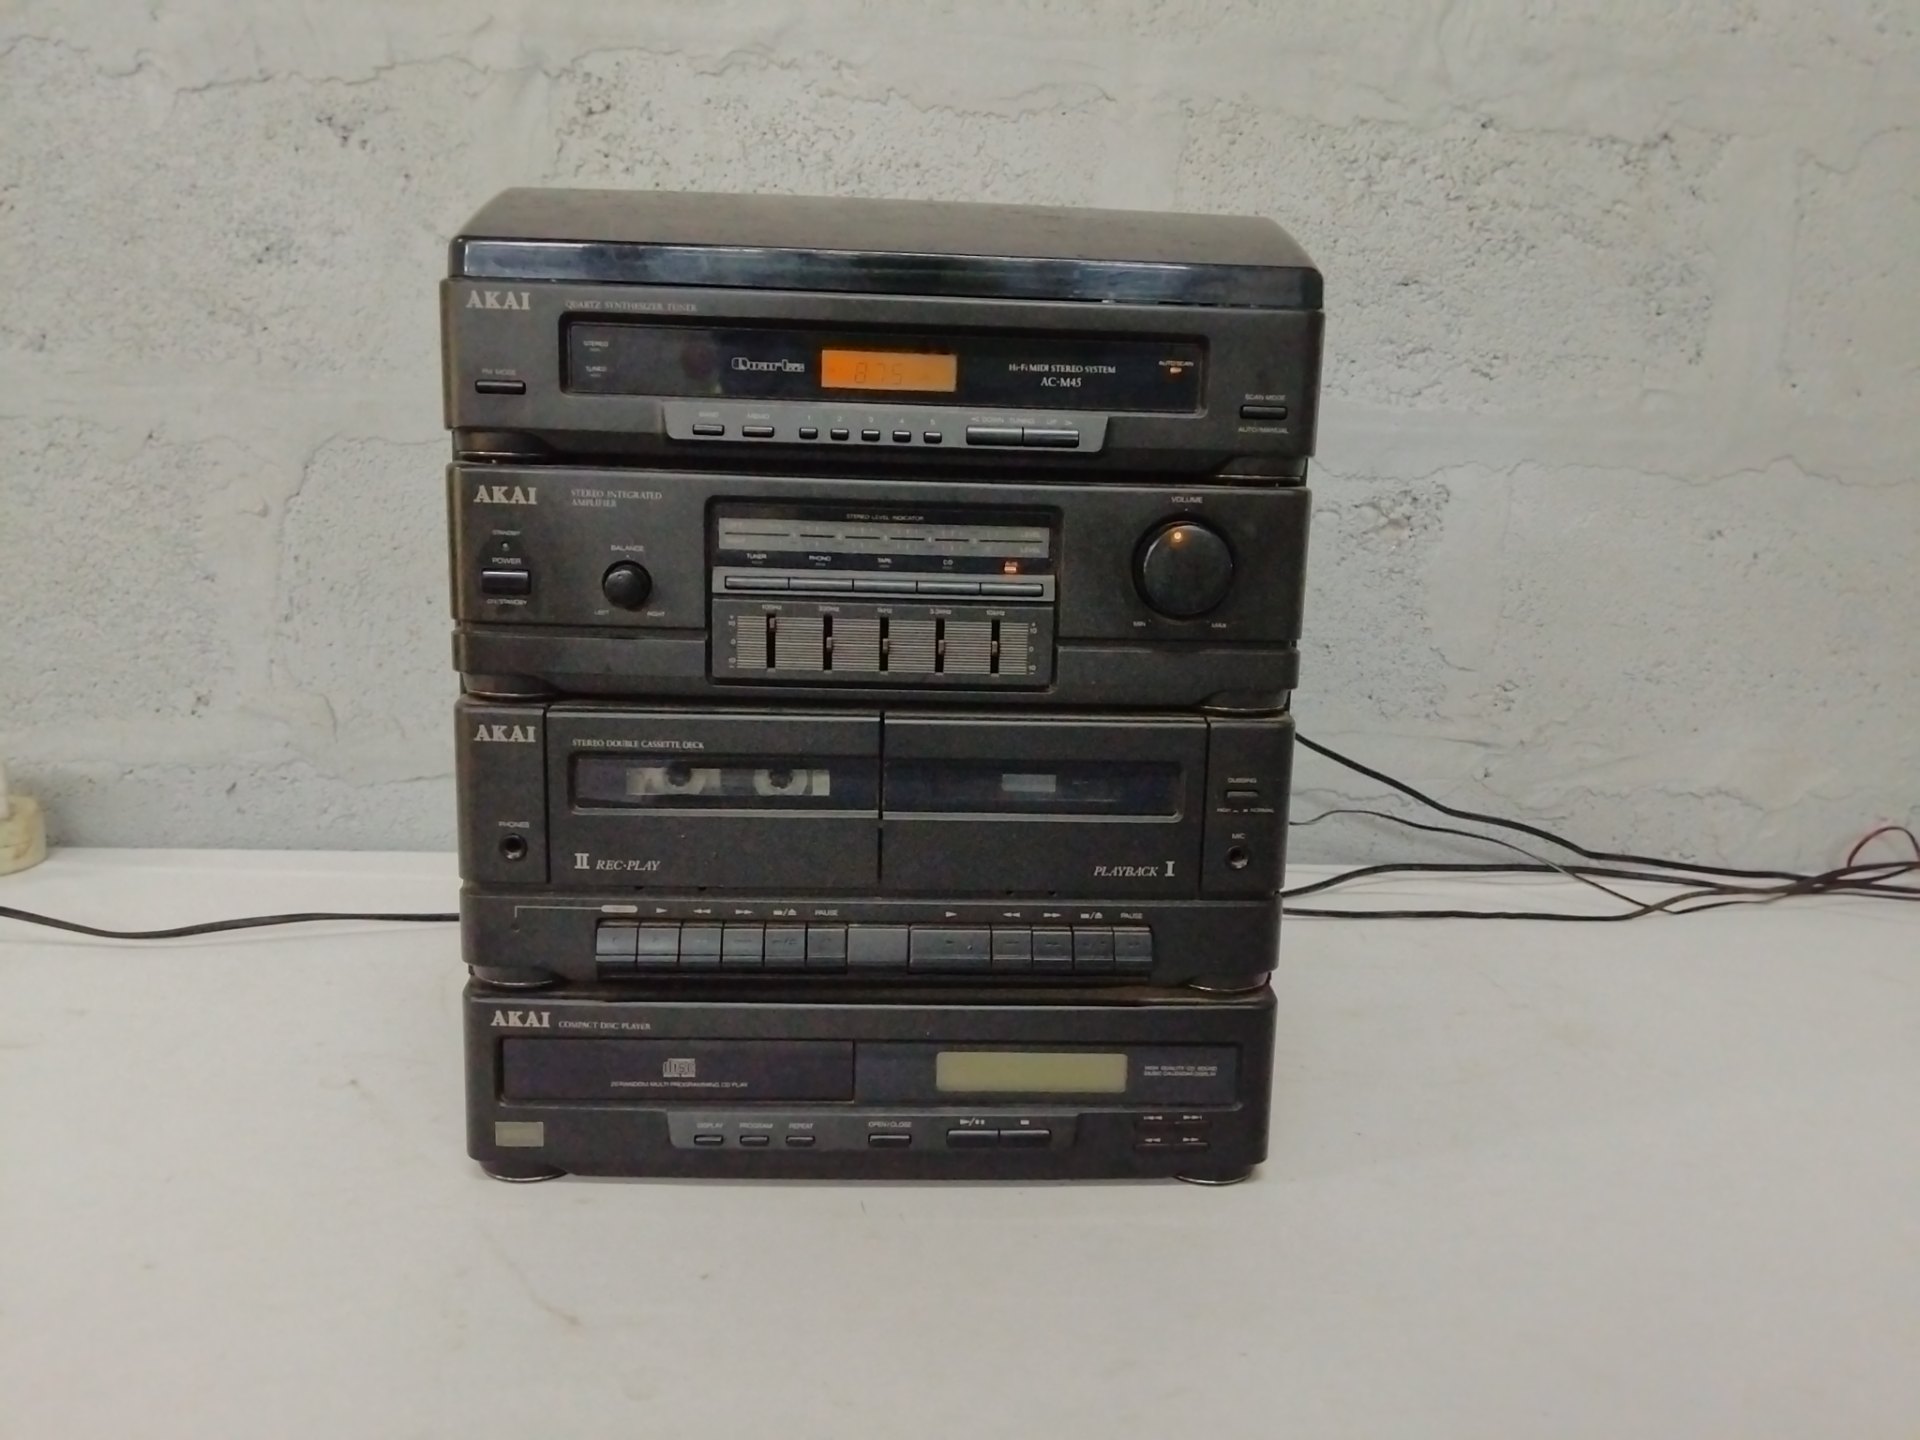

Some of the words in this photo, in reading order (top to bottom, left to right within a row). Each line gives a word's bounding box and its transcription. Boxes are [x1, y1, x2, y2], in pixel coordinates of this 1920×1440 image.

[466, 290, 531, 310] AKAI
[565, 301, 601, 310] QUARTZ
[604, 302, 663, 311] SYNTHESIZER
[667, 303, 698, 312] TUNER
[1029, 364, 1049, 373] MIDI
[1050, 364, 1083, 374] STEREO
[1085, 365, 1116, 374] SYSTEM
[473, 485, 537, 505] AKAI
[571, 489, 603, 498] STEREO
[607, 490, 662, 500] INTEGRATED
[1171, 496, 1203, 504] VOLUME
[572, 499, 617, 508] AMPLIFIER
[492, 557, 521, 565] POWER
[473, 724, 536, 744] AKAI
[572, 738, 605, 747] STEREO
[606, 739, 638, 748] DOUBLE
[641, 740, 681, 748] CASSETTE
[683, 741, 704, 749] DECK
[574, 853, 590, 870] II
[1093, 866, 1158, 877] PLAYBACK
[1164, 861, 1175, 877] I
[490, 1010, 551, 1028] AKAI
[558, 1021, 598, 1029] COMPACT
[600, 1021, 619, 1030] DISC
[621, 1022, 651, 1030] PLAYER
